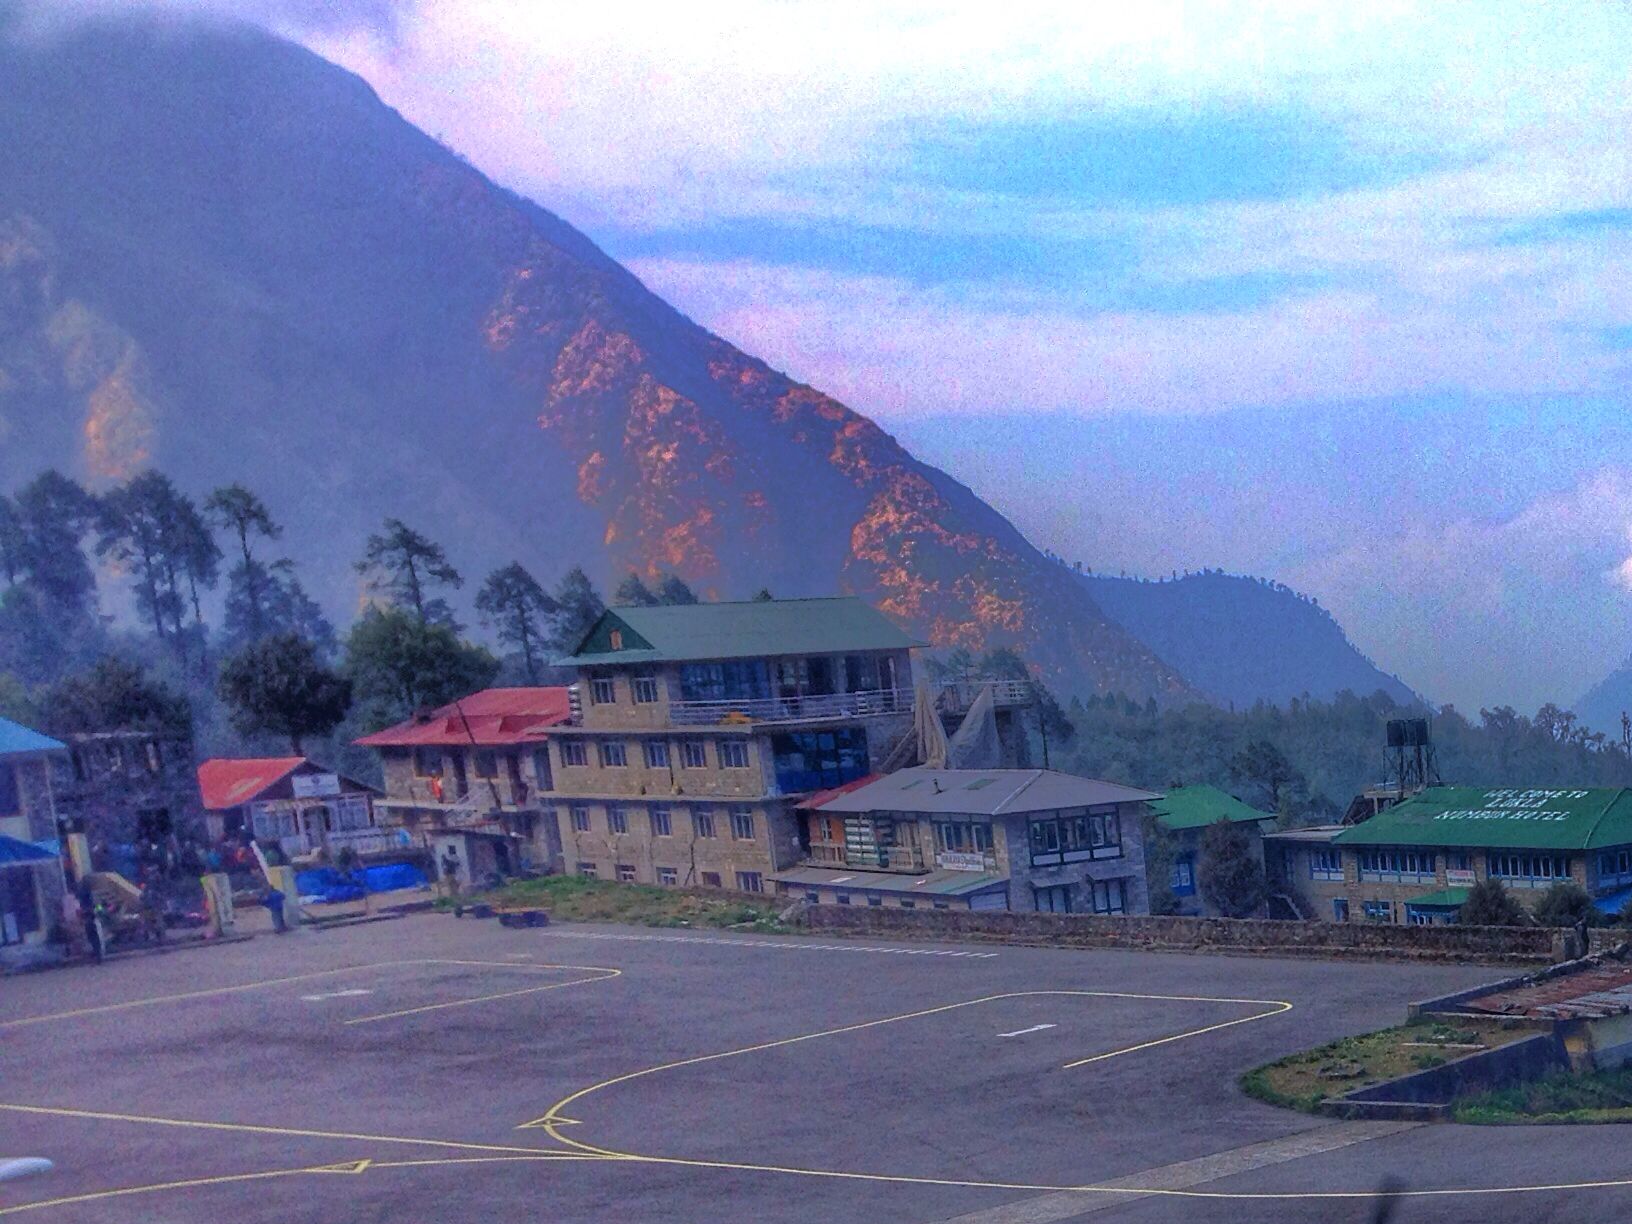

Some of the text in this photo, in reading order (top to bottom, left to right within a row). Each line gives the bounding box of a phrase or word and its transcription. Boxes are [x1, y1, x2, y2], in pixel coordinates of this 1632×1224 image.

[1482, 789, 1589, 799] WELCOME TO
[1507, 810, 1570, 821] HOTEL
